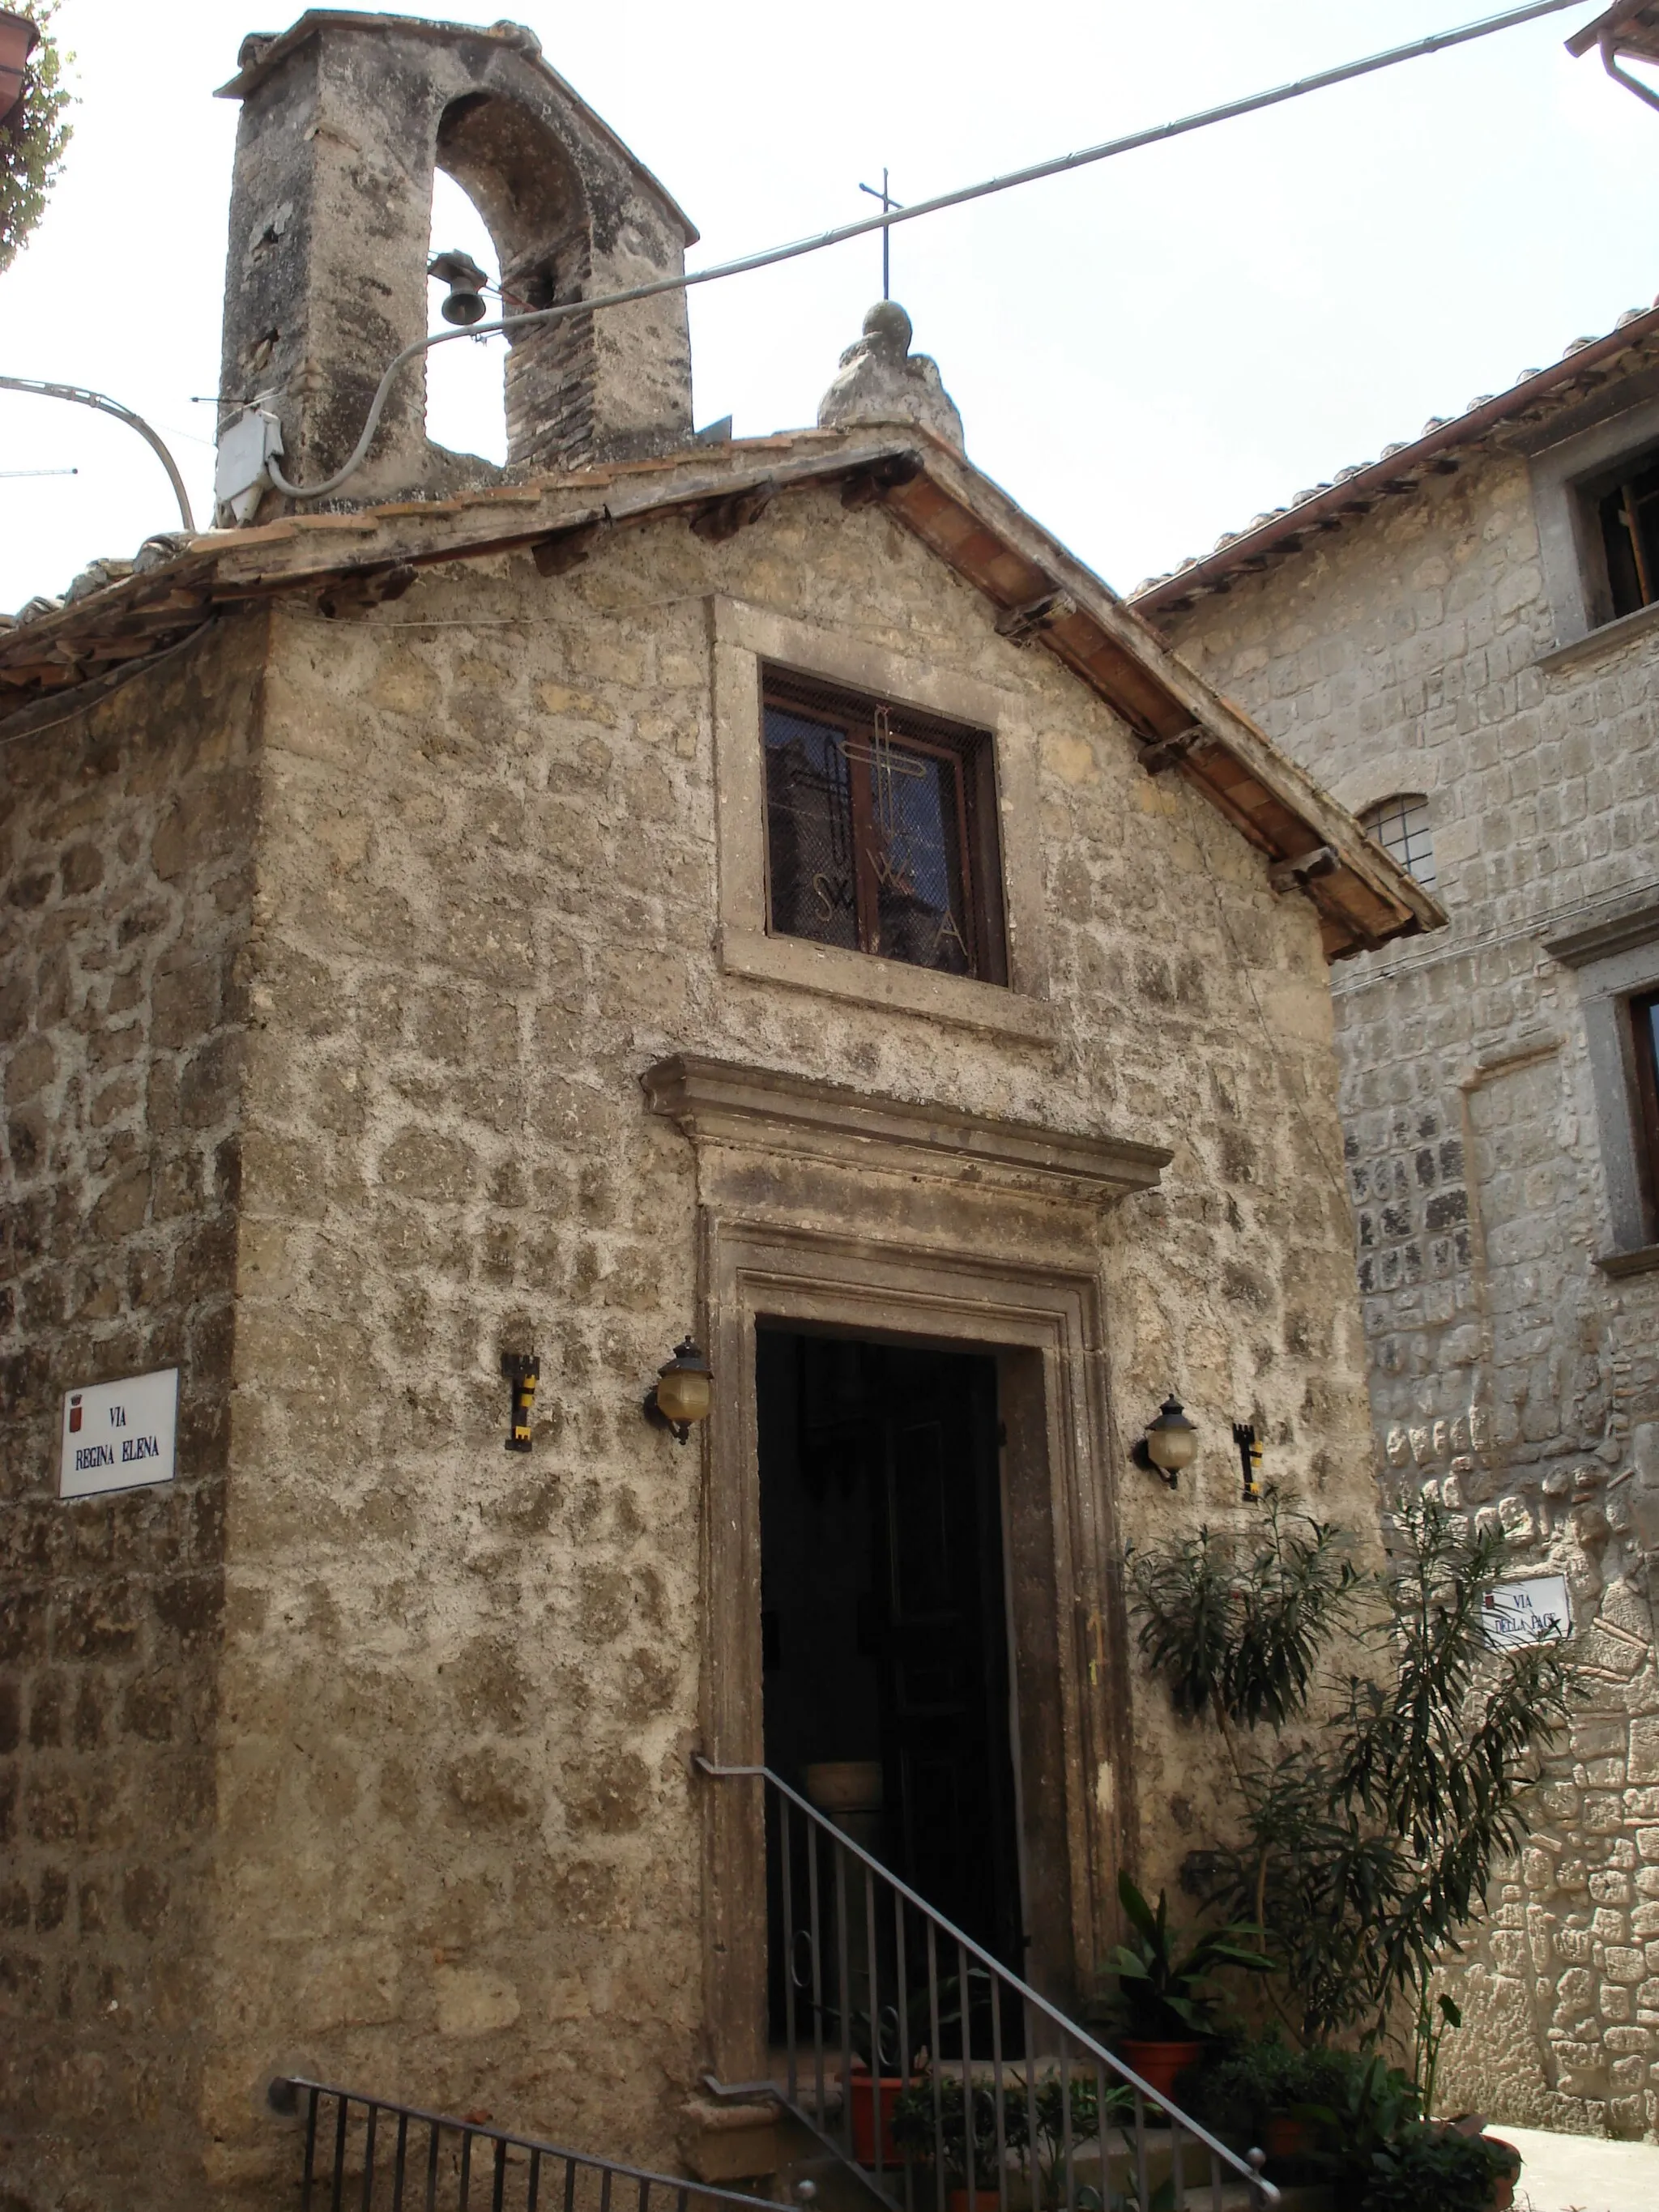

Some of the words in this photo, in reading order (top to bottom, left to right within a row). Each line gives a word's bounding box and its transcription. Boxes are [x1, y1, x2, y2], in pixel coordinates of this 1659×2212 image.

[109, 1406, 126, 1427] VIA
[76, 1445, 114, 1471] REGINA
[122, 1436, 159, 1462] ELENA
[1513, 1594, 1533, 1609] VIA
[1495, 1617, 1525, 1633] DELLA
